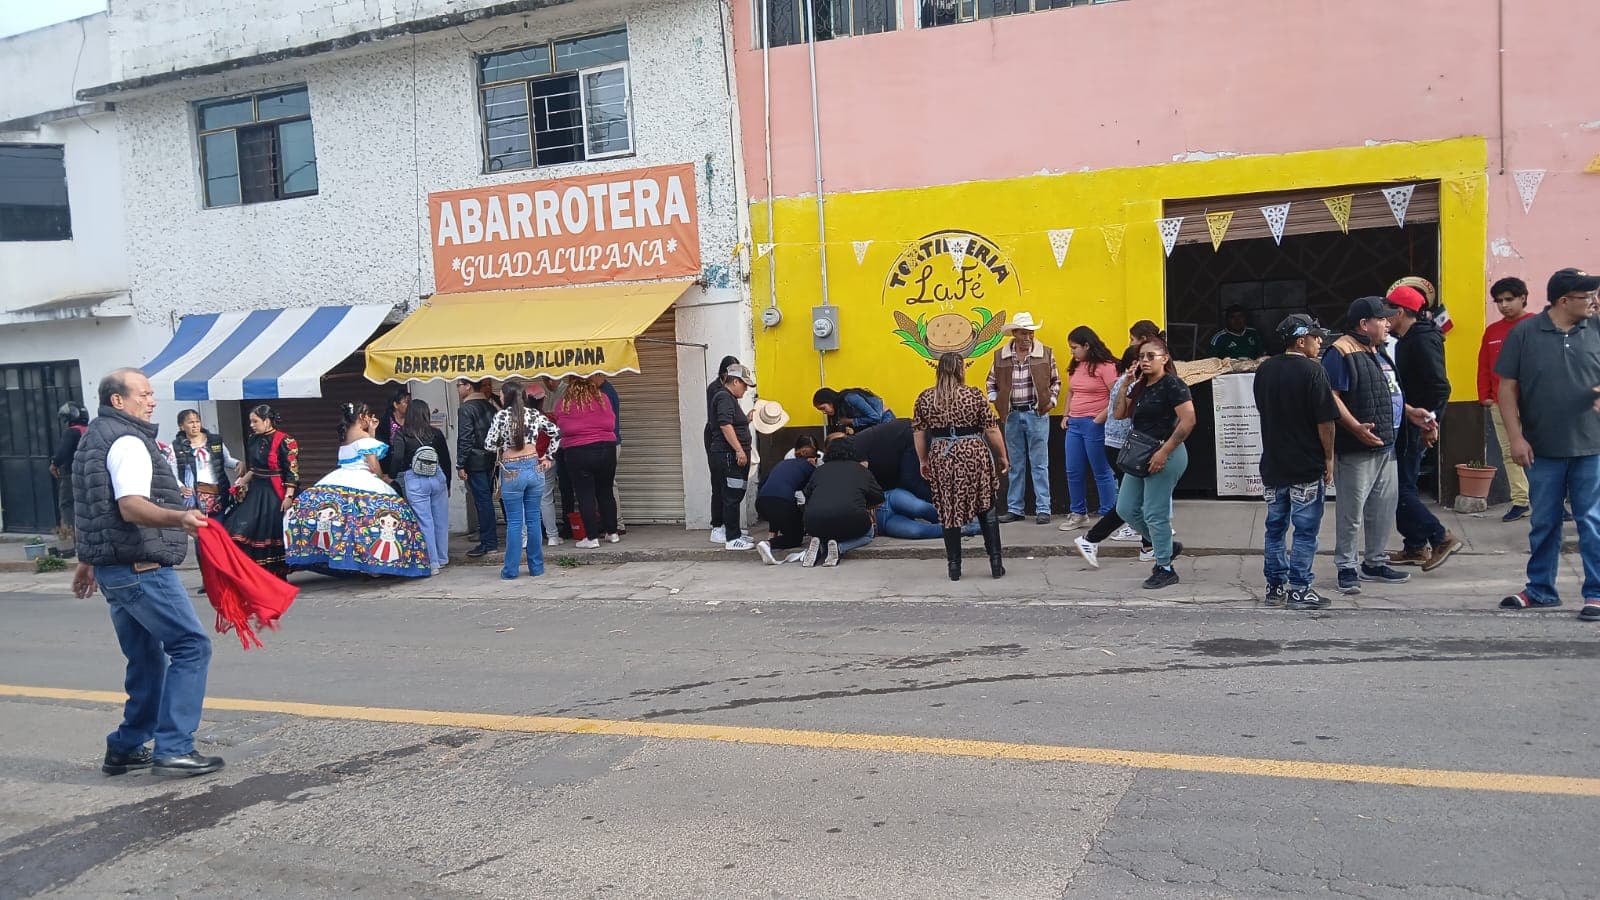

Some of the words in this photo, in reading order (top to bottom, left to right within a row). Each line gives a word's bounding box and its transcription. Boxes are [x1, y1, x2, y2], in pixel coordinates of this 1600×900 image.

[437, 175, 691, 247] ABARROTERA
[889, 238, 1010, 288] TOTILERIA
[905, 264, 954, 305] La
[394, 354, 485, 374] ABARROTERA
[494, 346, 605, 372] GUADALUPANA
